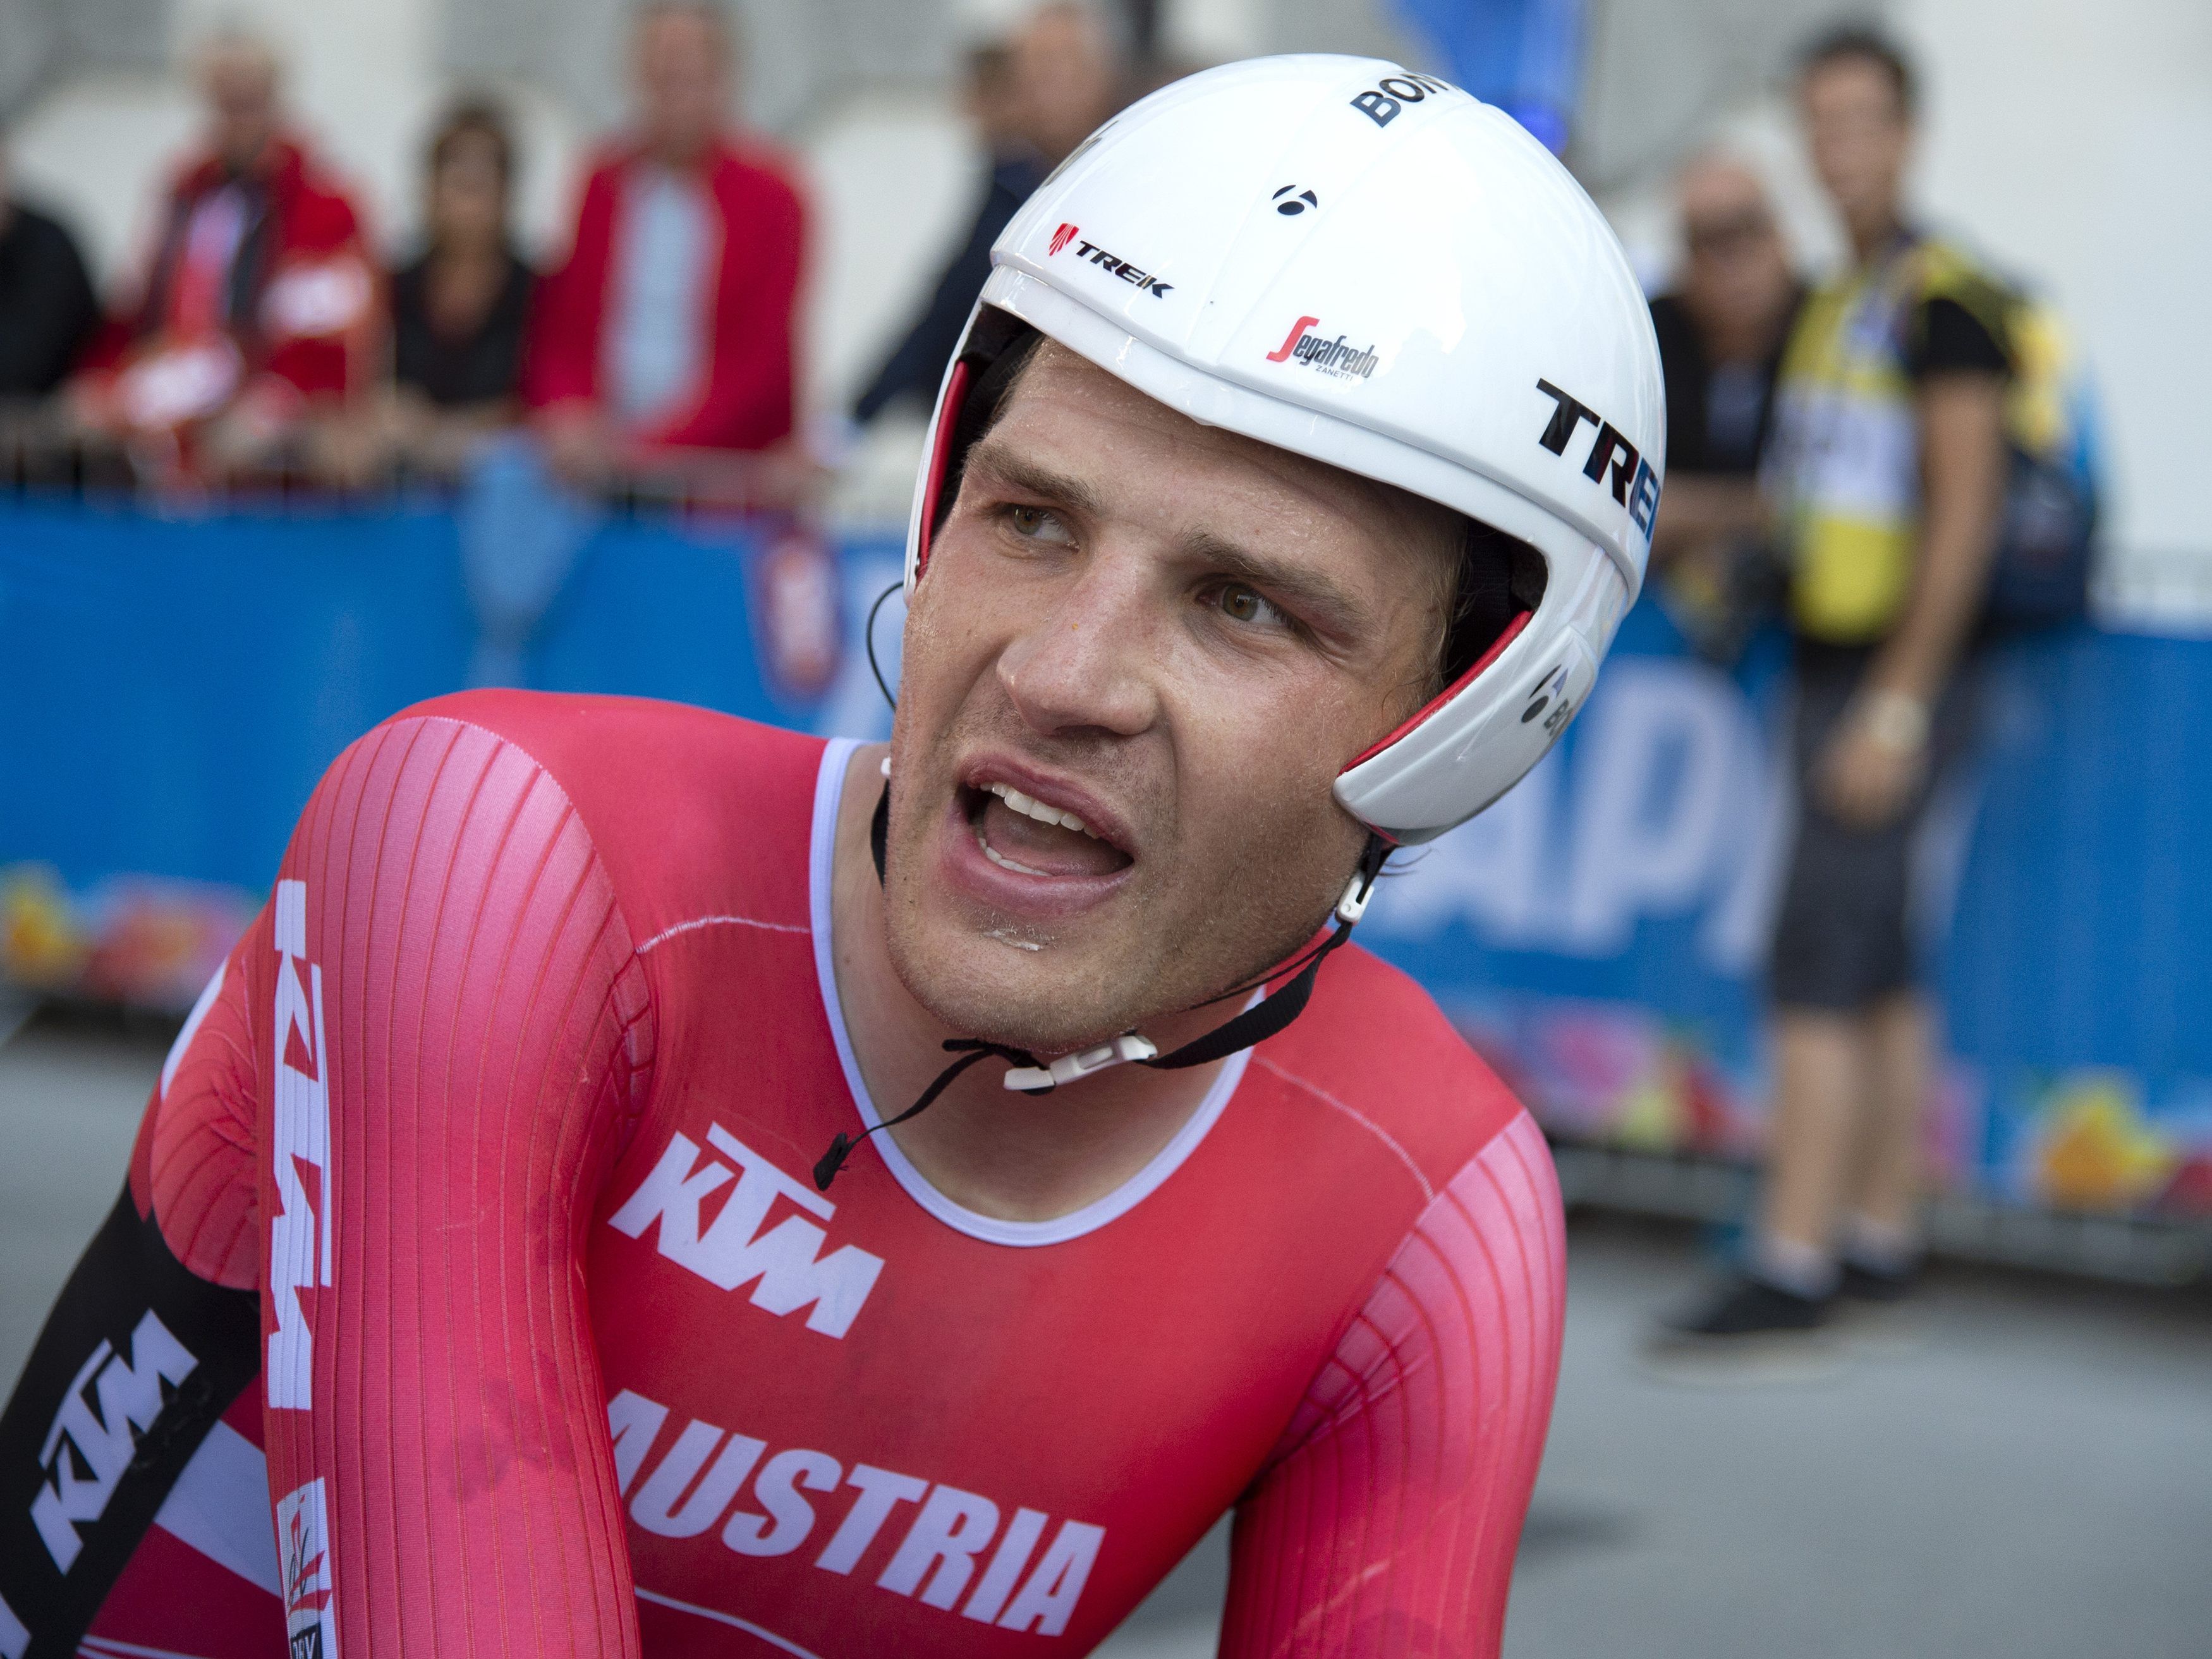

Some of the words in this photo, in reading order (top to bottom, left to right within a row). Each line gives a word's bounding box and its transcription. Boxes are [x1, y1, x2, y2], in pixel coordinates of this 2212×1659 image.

[1076, 240, 1175, 298] TREK
[1266, 315, 1380, 379] Segafredo
[1316, 365, 1354, 382] ZANETTI
[607, 1121, 885, 1340] KTM
[29, 1308, 199, 1576] KTM
[607, 1389, 1107, 1637] AUSTRIA
